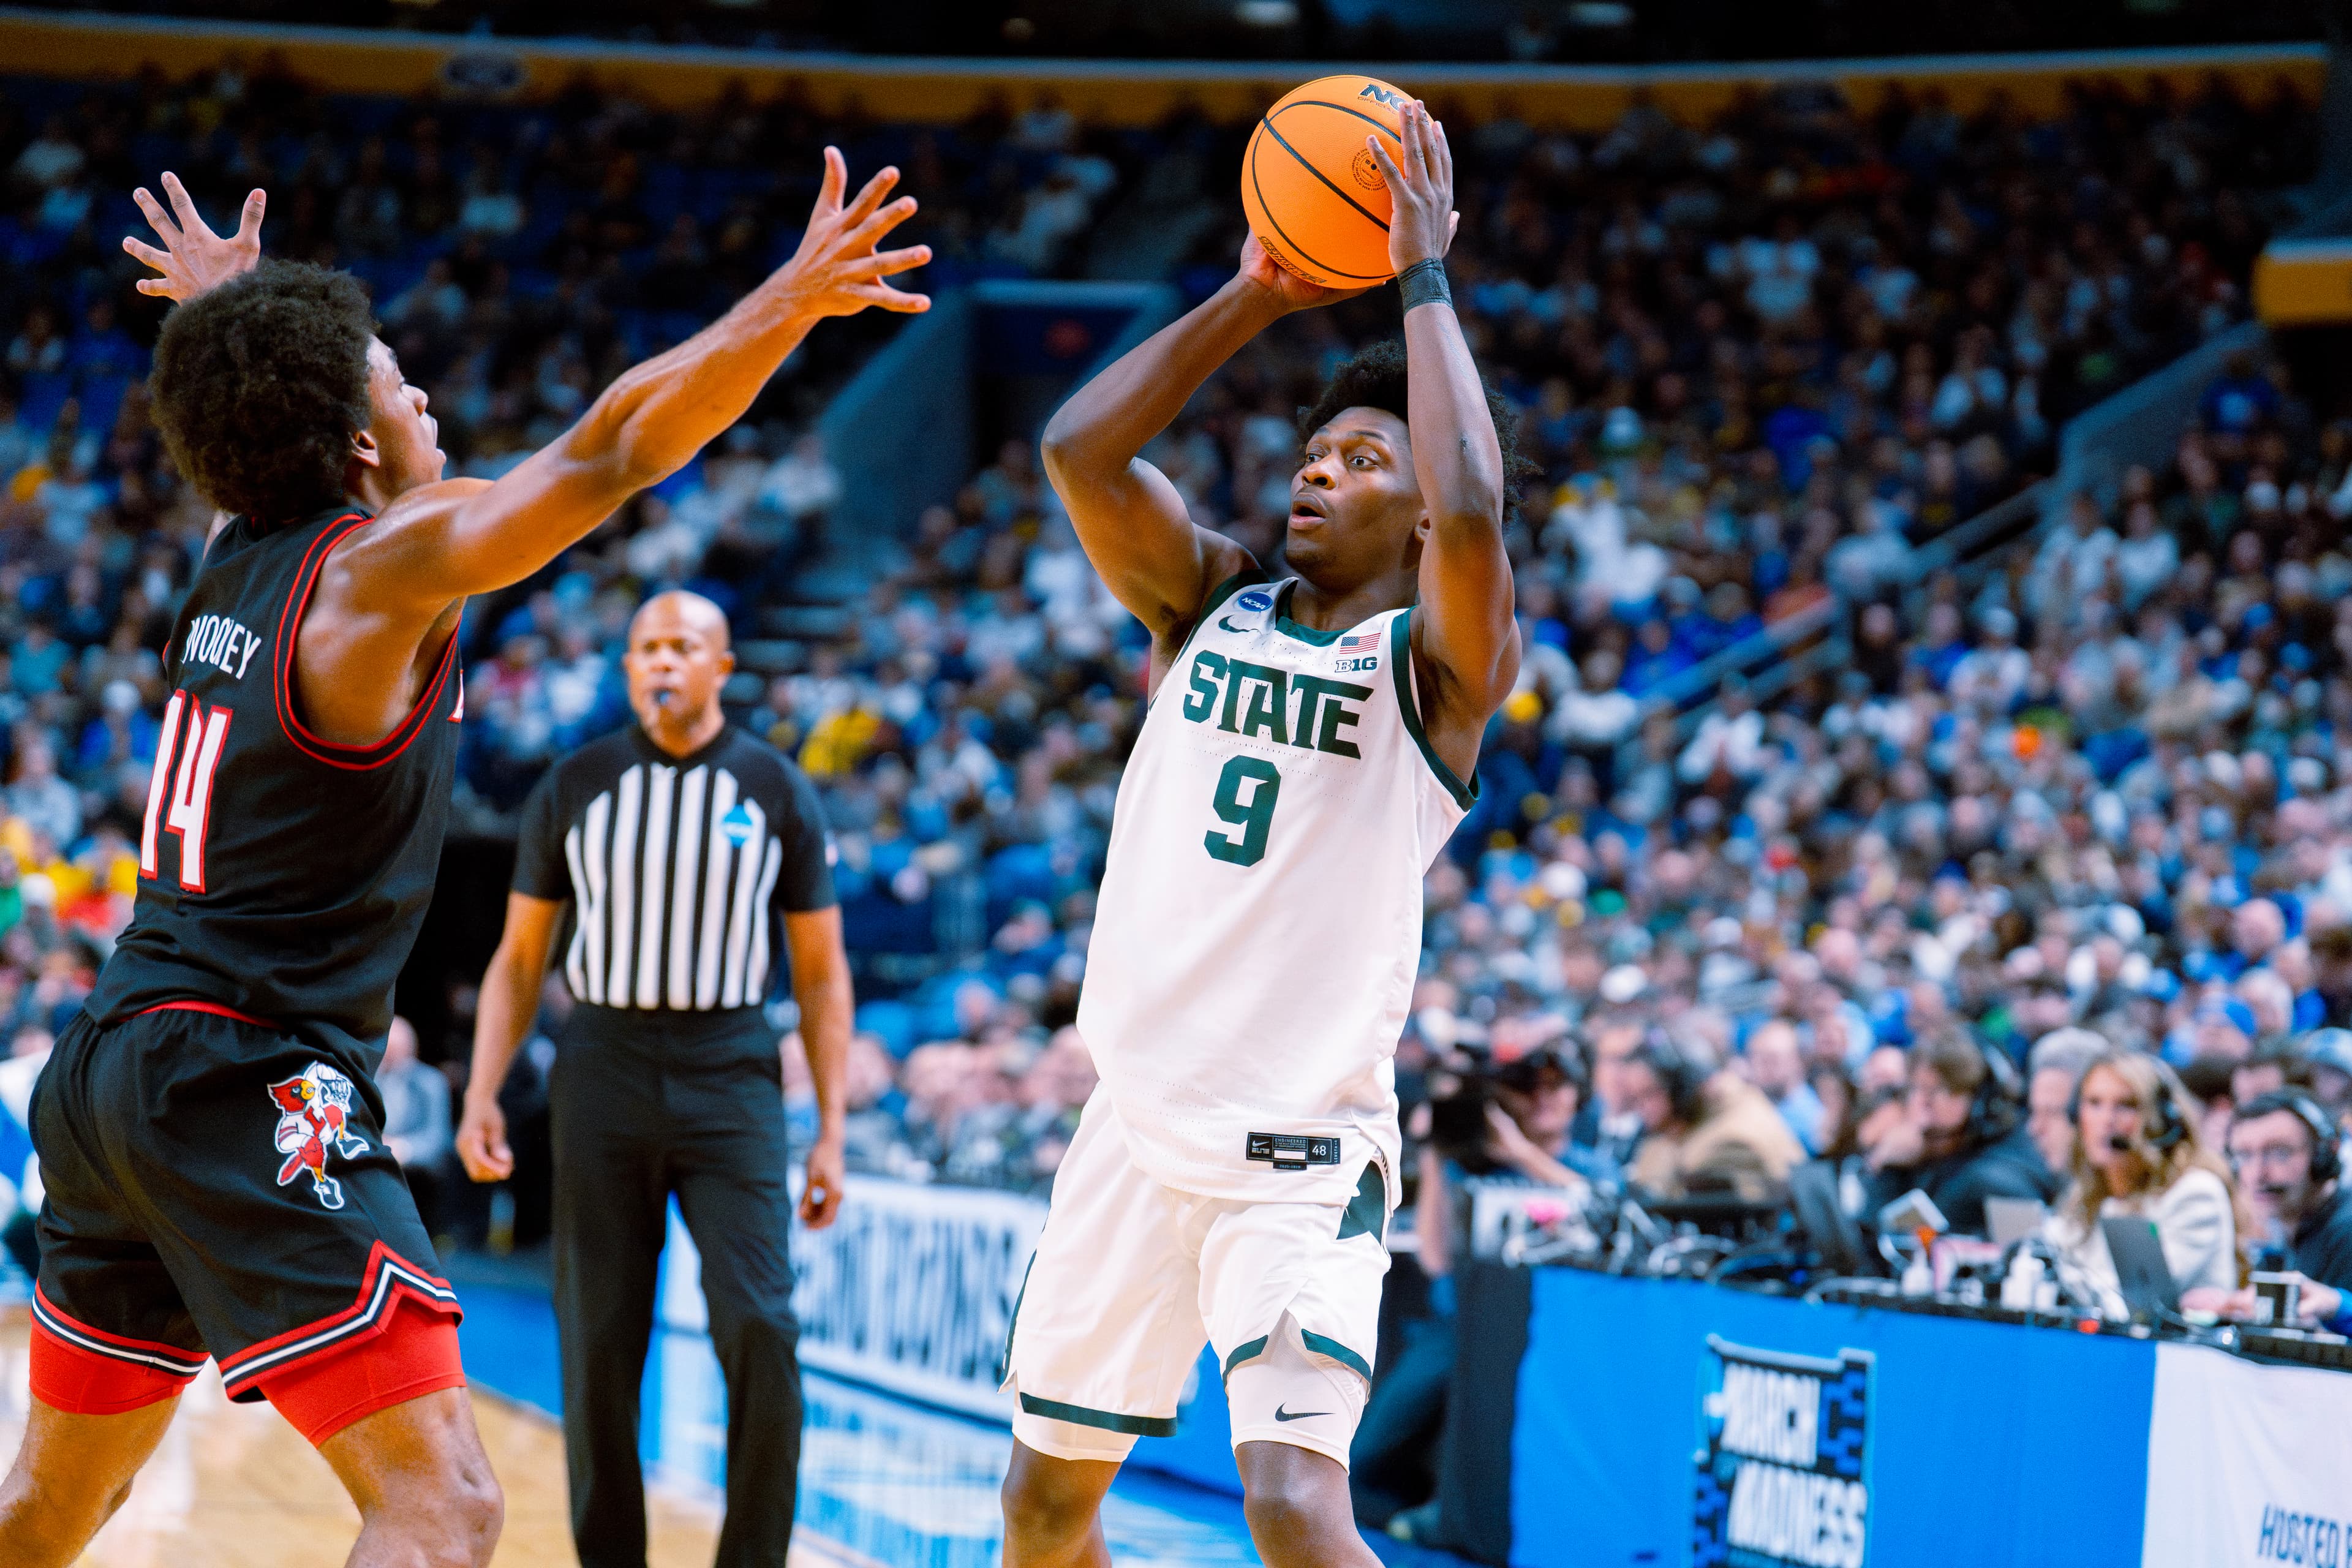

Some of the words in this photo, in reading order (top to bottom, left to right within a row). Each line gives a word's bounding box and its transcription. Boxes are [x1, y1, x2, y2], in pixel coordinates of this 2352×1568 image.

[1359, 83, 1406, 113] NC
[1242, 597, 1267, 610] NCAA
[1183, 649, 1374, 760] STATE
[140, 688, 233, 895] 14
[1204, 755, 1281, 867] 9
[1312, 1145, 1327, 1156] 48
[2258, 1502, 2341, 1568] HOSTED
